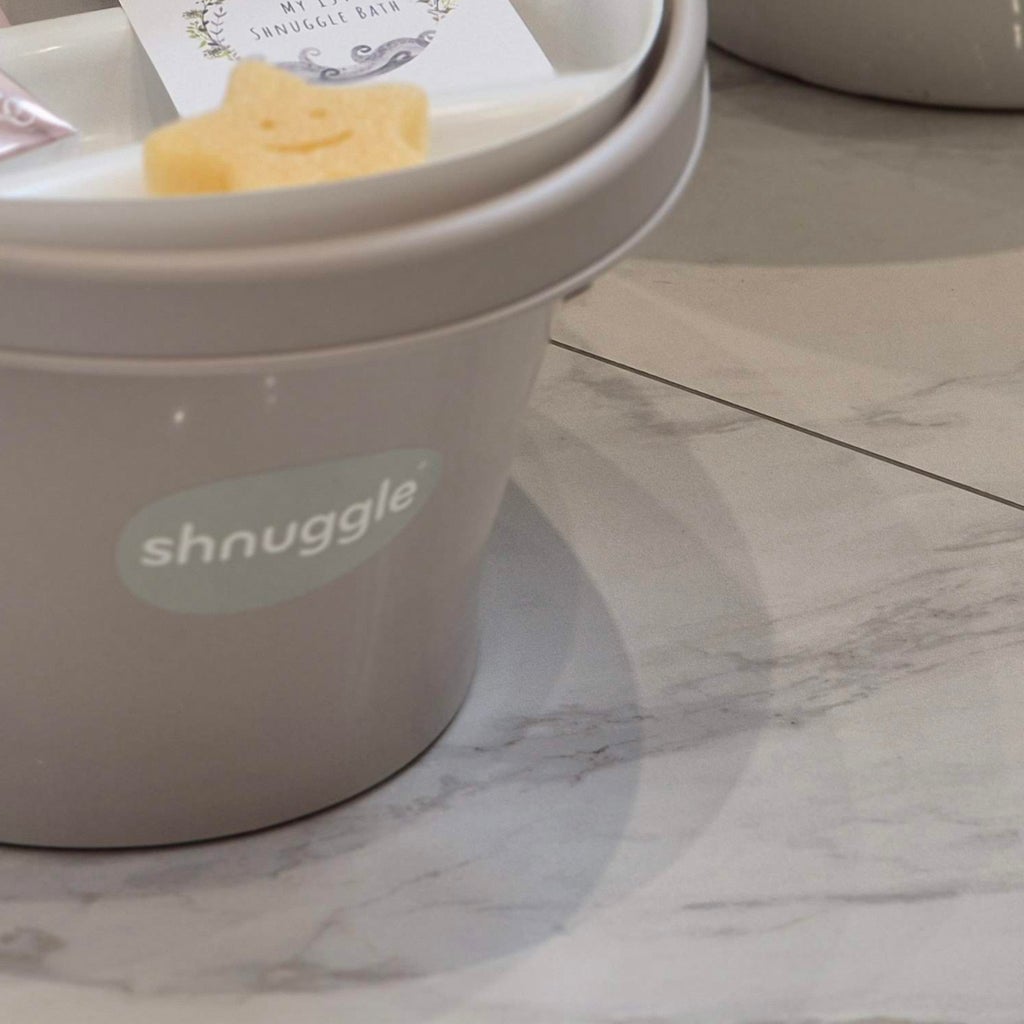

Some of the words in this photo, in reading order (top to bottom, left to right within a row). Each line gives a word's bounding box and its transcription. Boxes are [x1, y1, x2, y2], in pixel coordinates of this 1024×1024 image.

[249, 11, 349, 41] SHNUGGLE
[355, 0, 400, 20] BATH
[280, 0, 306, 15] MY
[140, 478, 418, 567] shnuggle
